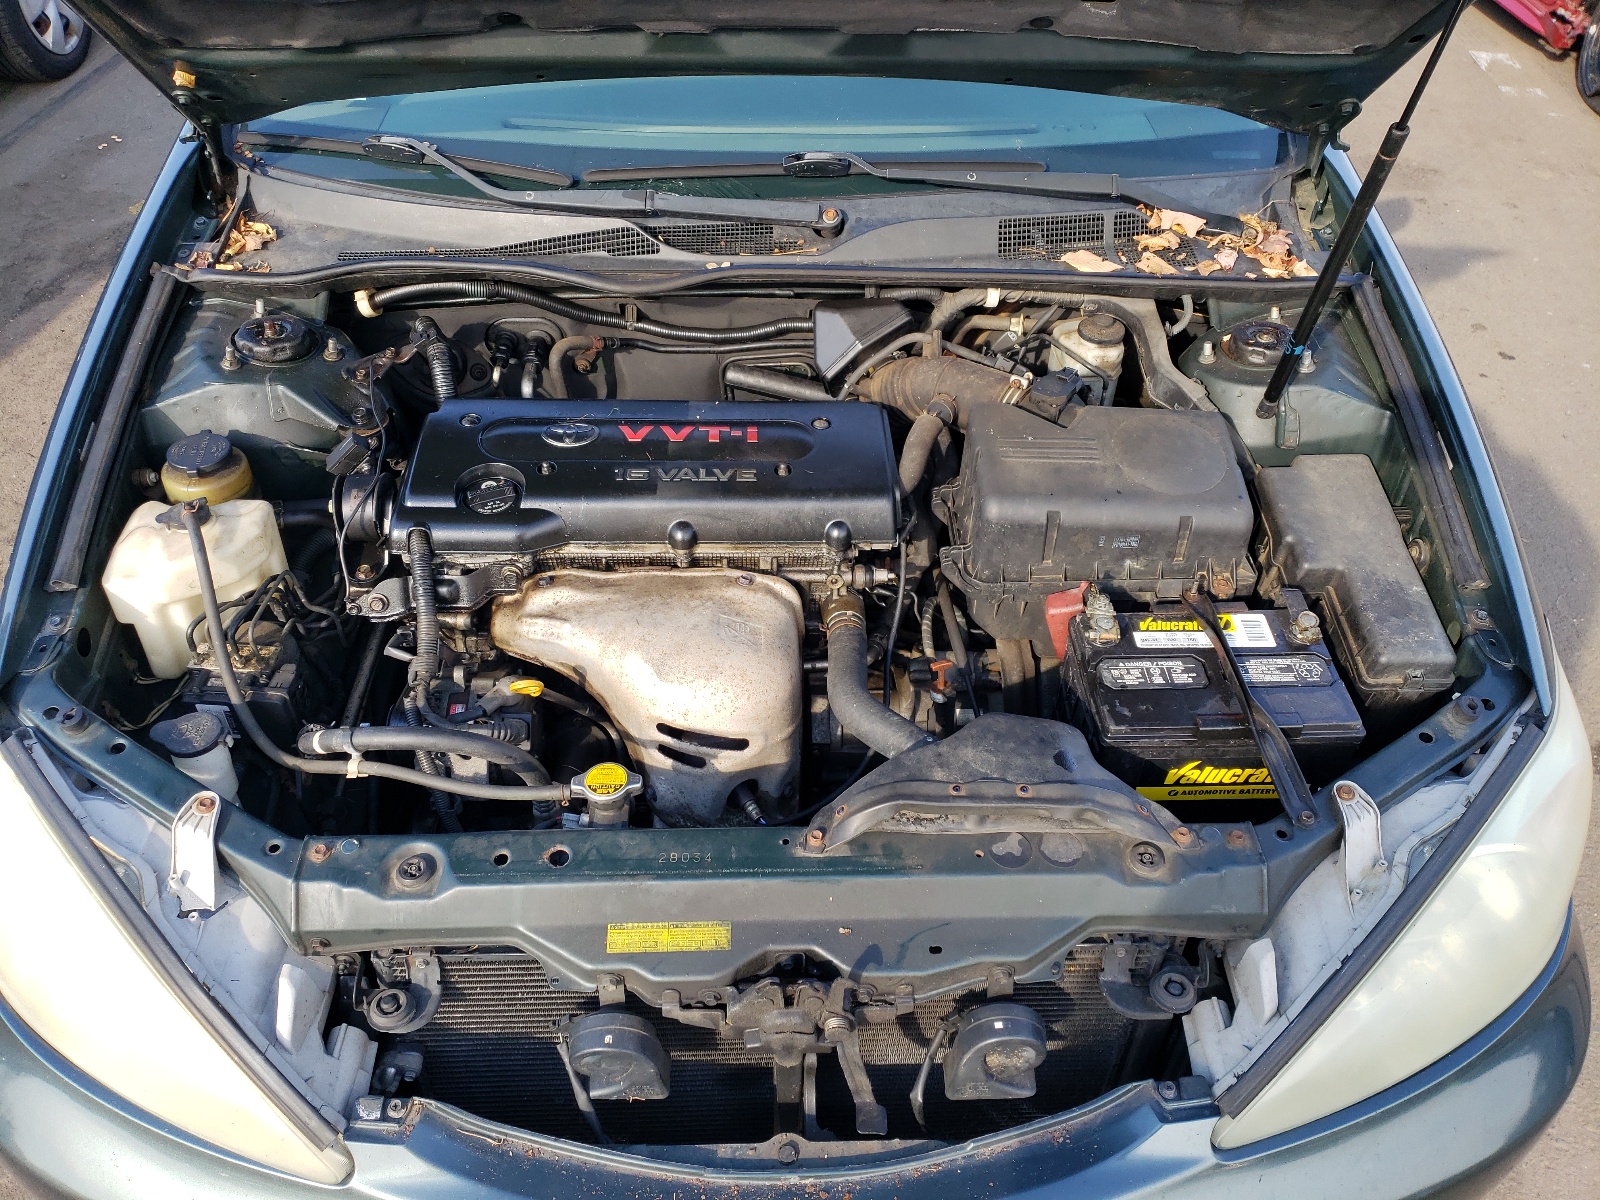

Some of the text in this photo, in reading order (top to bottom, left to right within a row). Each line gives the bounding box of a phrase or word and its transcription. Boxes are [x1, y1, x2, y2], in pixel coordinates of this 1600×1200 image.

[614, 468, 758, 482] 16 VALVE
[1139, 616, 1203, 631] Valucraf
[1164, 760, 1272, 785] Valucra
[658, 852, 712, 863] 28034
